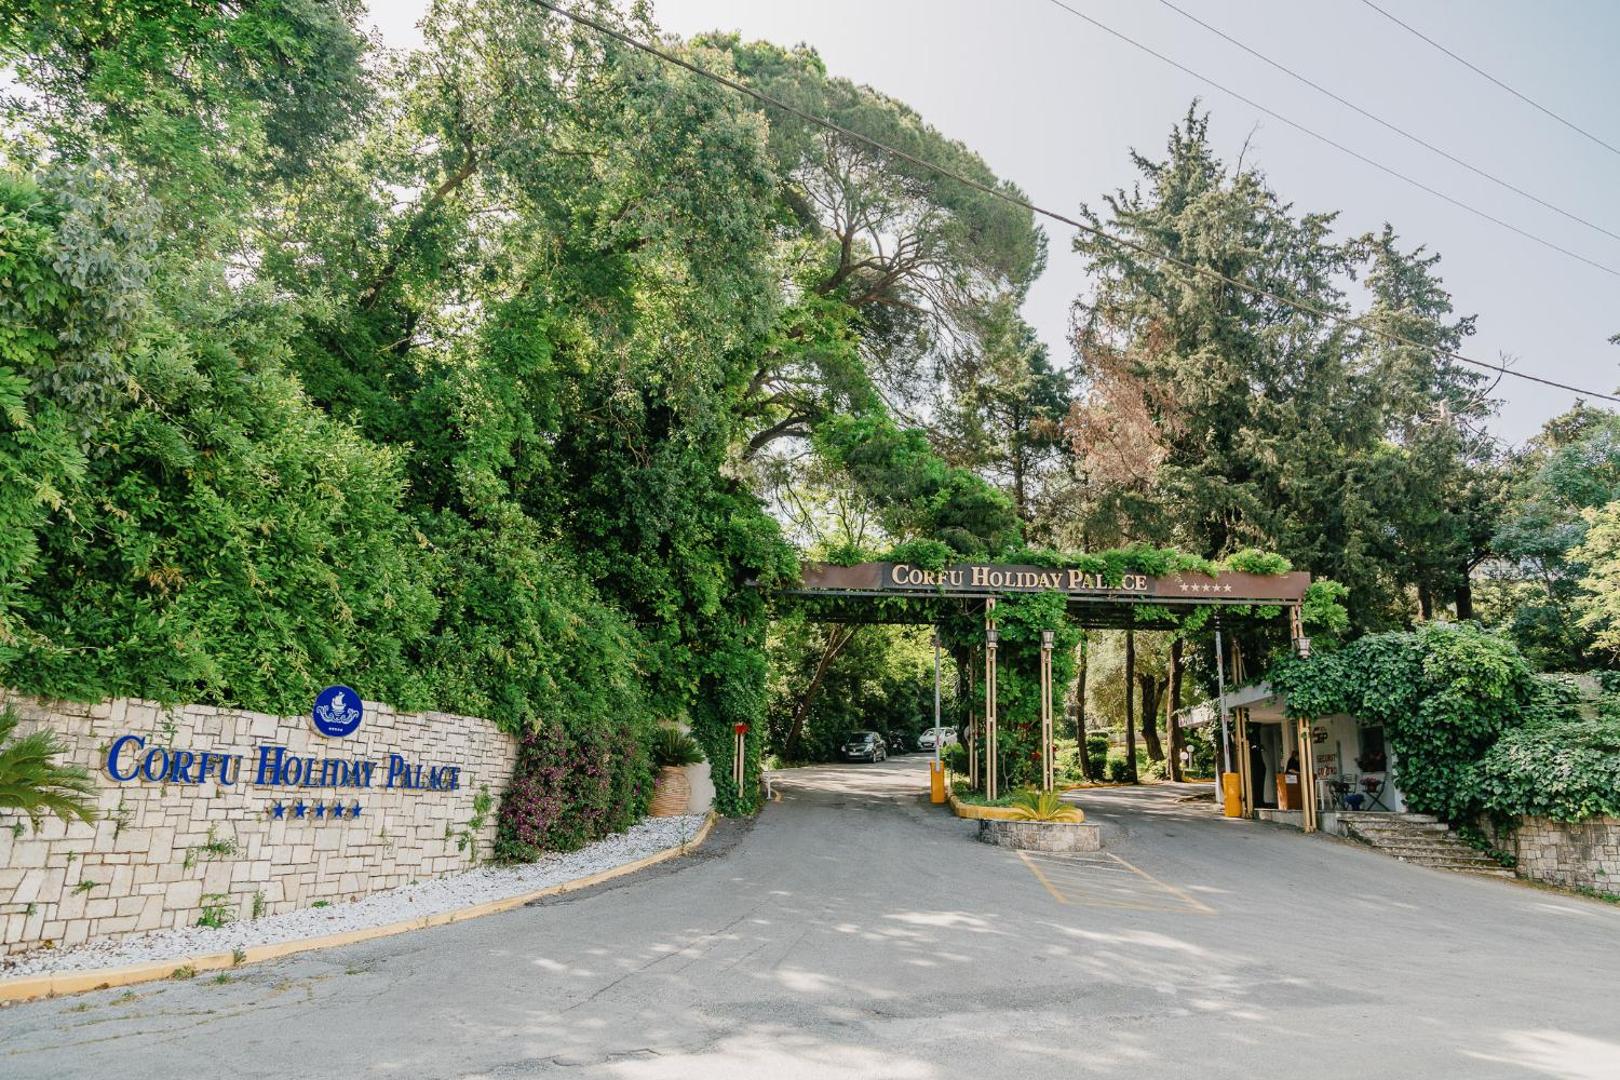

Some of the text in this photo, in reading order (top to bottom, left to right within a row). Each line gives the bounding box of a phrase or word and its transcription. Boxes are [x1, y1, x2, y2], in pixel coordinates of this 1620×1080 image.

[891, 564, 1148, 591] CORFU HOLIDAY PALCE
[107, 734, 461, 791] CORFU HOLIDAY PALACE
